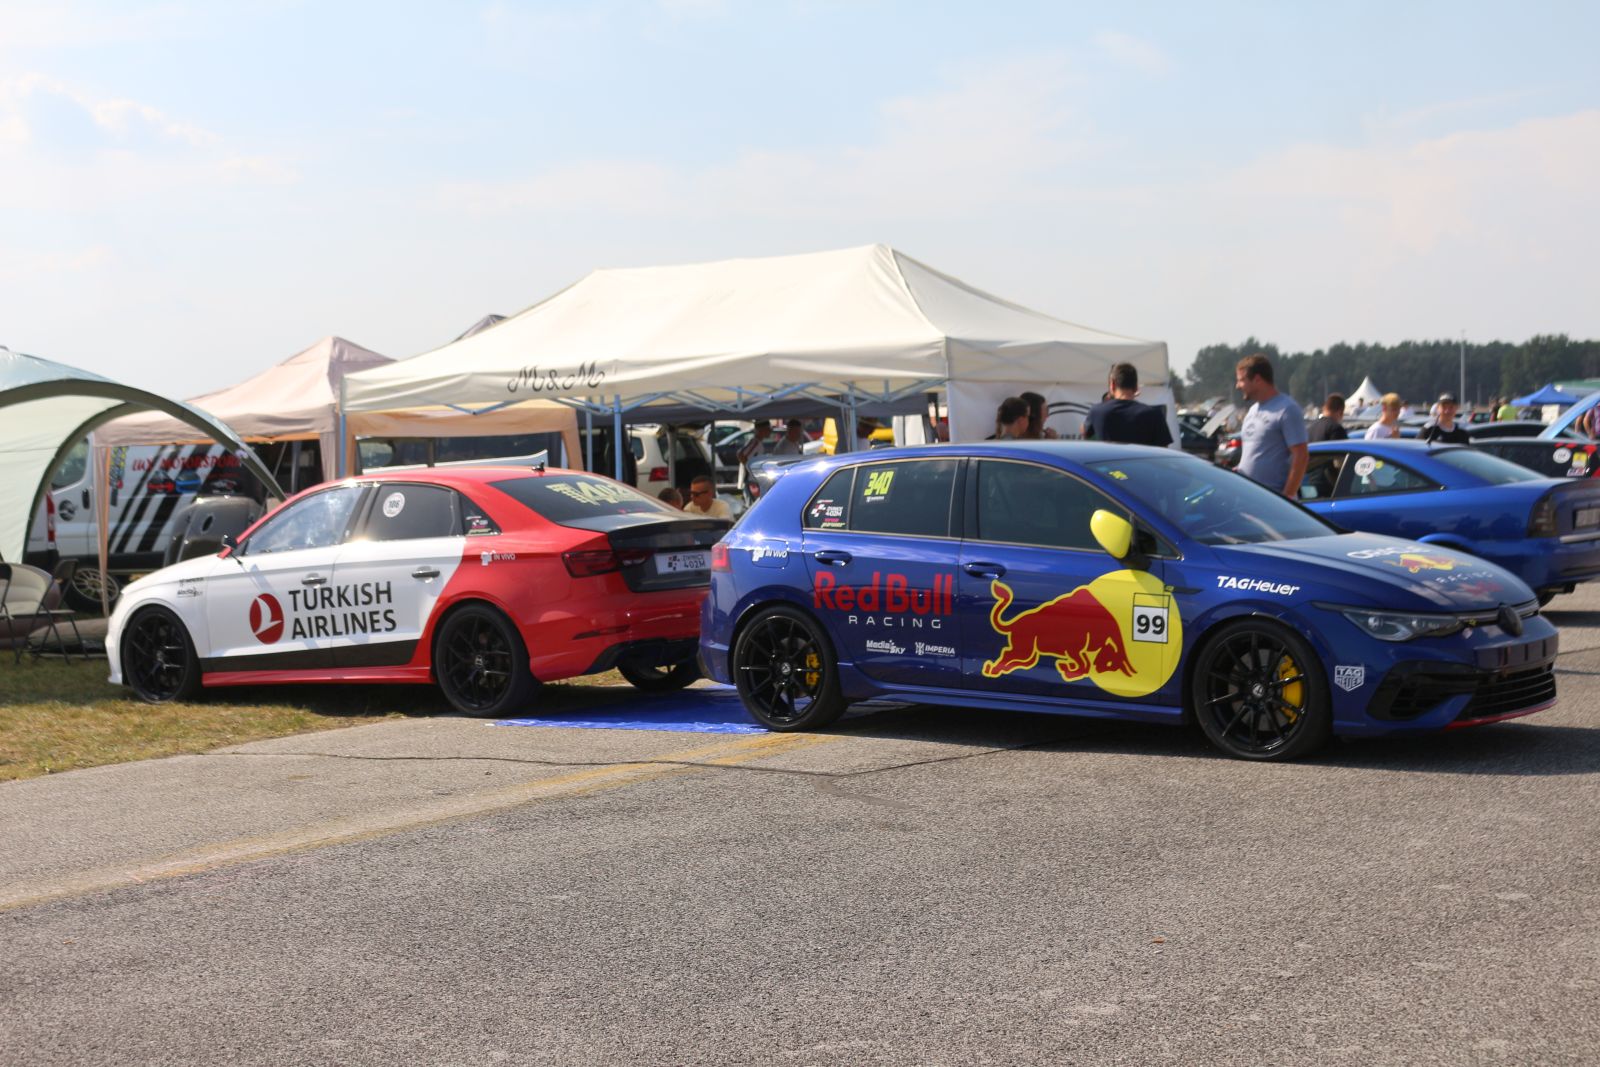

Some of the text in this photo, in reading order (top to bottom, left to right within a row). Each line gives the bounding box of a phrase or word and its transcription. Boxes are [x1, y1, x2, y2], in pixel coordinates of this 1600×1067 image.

[864, 471, 894, 496] 340
[684, 560, 706, 569] 402M
[288, 581, 393, 612] TURKISH
[813, 570, 953, 616] Red Bull
[291, 609, 397, 640] AIRLINES
[848, 615, 941, 629] RACING
[1136, 614, 1166, 635] 99
[925, 645, 956, 654] IMPERIA
